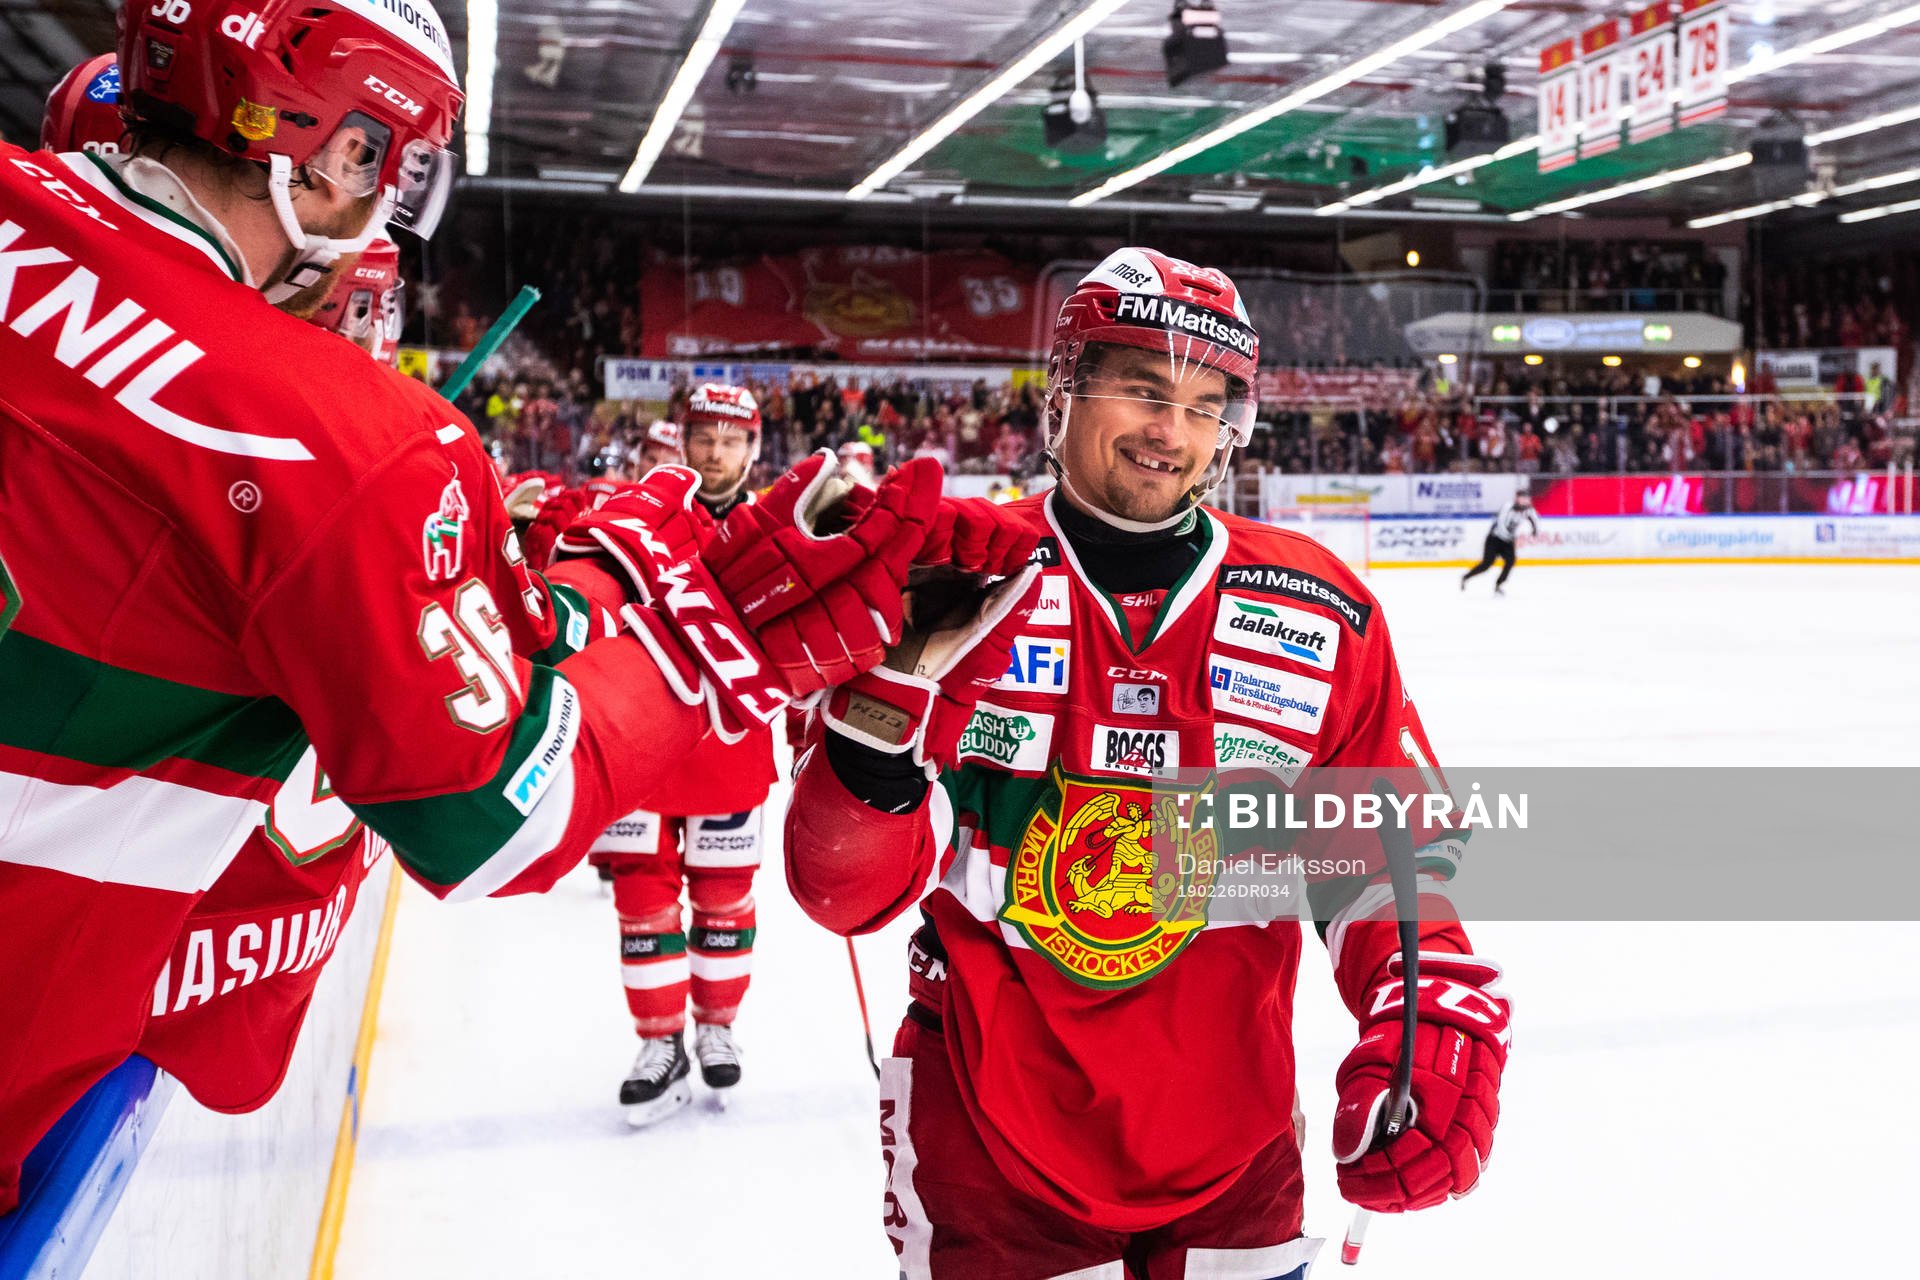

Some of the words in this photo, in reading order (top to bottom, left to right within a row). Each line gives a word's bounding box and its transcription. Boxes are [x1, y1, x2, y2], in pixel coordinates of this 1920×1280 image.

[1637, 44, 1665, 98] 24
[1687, 21, 1718, 77] 78
[363, 74, 424, 116] CCM
[1547, 83, 1566, 131] 14
[1588, 64, 1609, 114] 17
[1117, 295, 1157, 321] FM
[1160, 301, 1255, 358] Mattsson
[1226, 570, 1262, 584] FM
[1265, 572, 1361, 626] Mattsson
[1229, 614, 1326, 652] dalakraft
[1106, 666, 1169, 681] CCM
[1233, 671, 1281, 693] Dalarnas
[1231, 682, 1320, 718] Försäkringsbolag
[960, 732, 1018, 760] BUDDY
[1235, 749, 1292, 775] Electric
[1017, 828, 1048, 904] MORA
[1043, 930, 1173, 977] ISHOCKEY-
[1369, 979, 1512, 1050] CC
